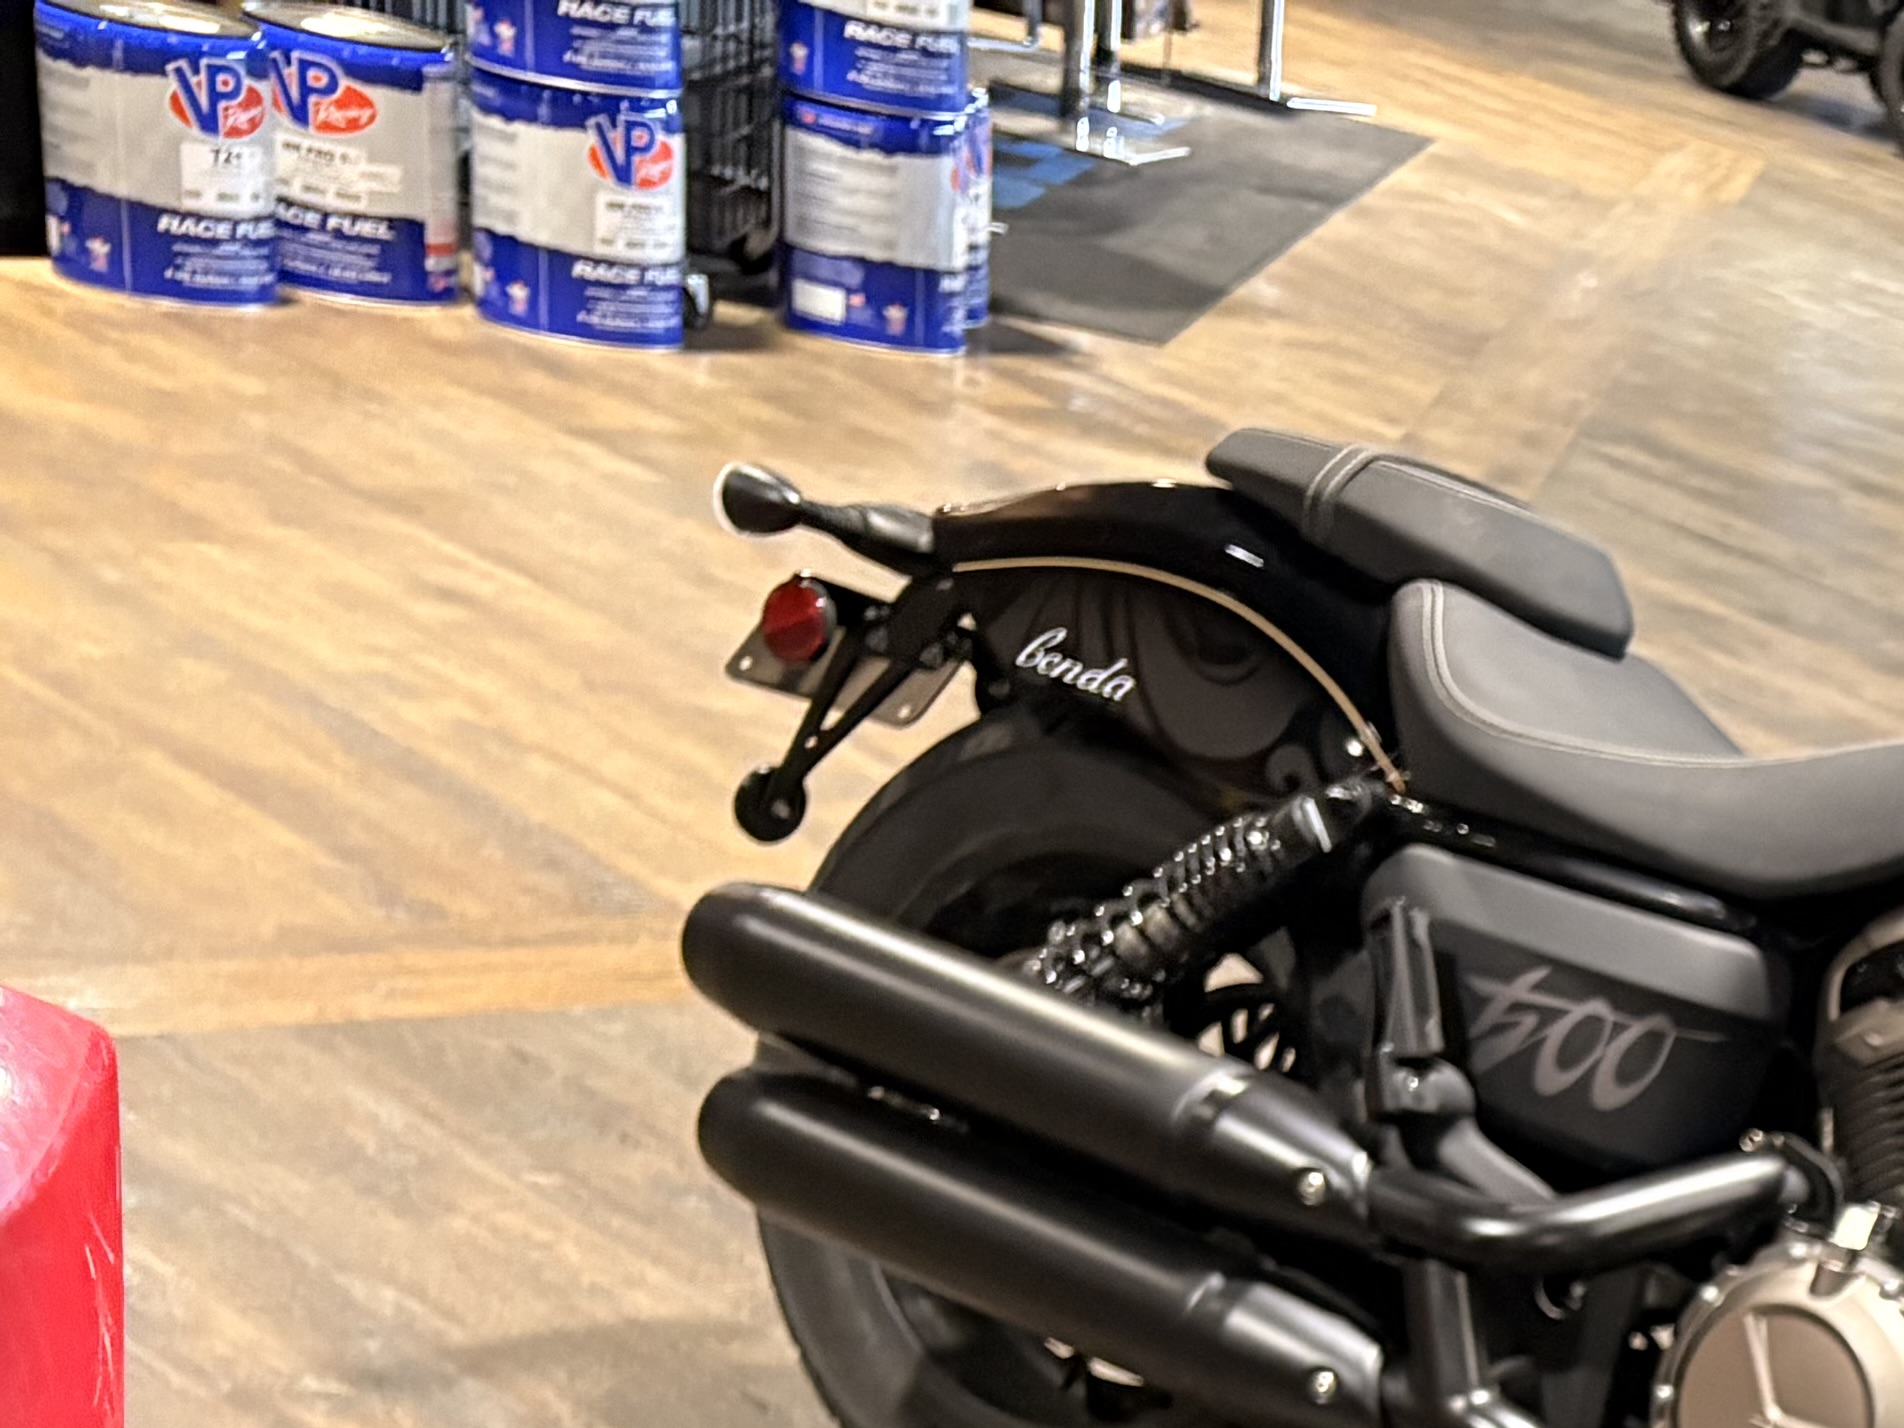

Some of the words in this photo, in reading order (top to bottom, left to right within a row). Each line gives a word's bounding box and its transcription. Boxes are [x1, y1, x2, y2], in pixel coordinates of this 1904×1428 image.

[585, 112, 657, 189] VP
[157, 212, 233, 239] RACE
[327, 207, 396, 241] FUEL
